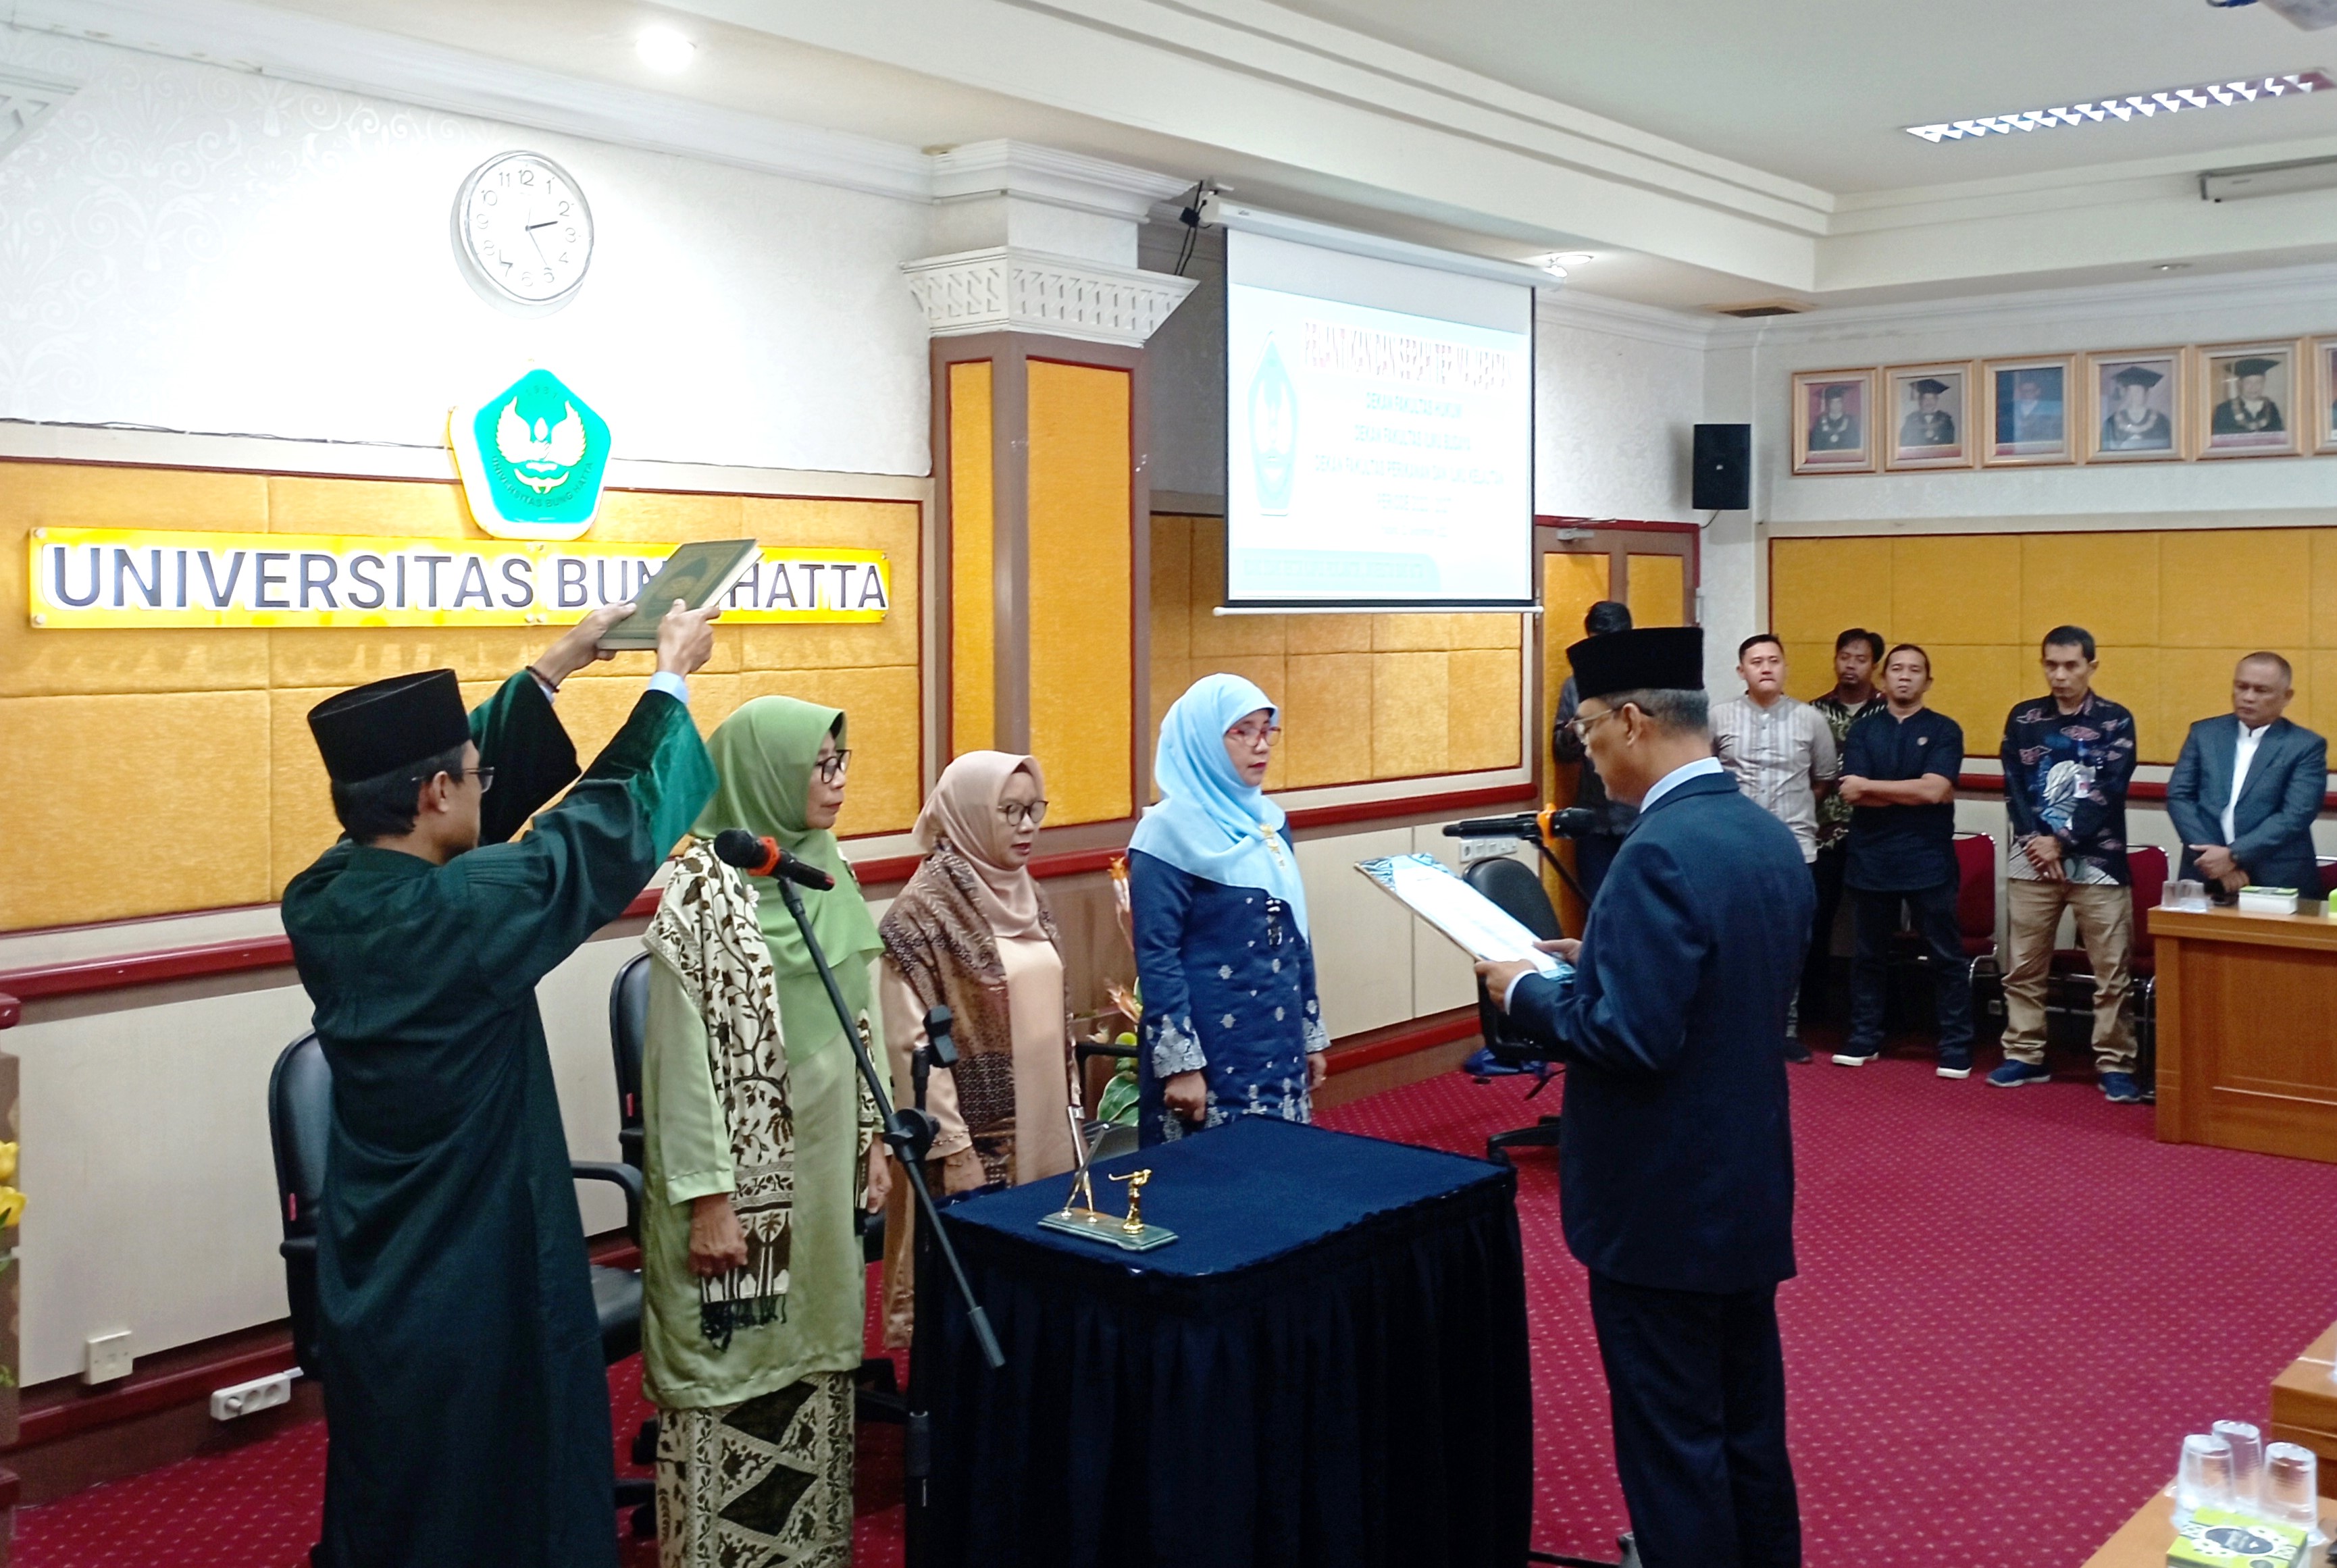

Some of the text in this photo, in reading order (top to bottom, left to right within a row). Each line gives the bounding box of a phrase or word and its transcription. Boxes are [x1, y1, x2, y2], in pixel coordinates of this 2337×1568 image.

[498, 172, 511, 188] 11
[518, 169, 534, 186] 12
[546, 180, 551, 194] 1
[481, 190, 498, 207] 10
[558, 201, 570, 217] 2
[476, 213, 488, 230] 9
[565, 227, 576, 243] 3
[484, 240, 495, 256] 8
[558, 251, 569, 263] 4
[521, 271, 534, 287] 6
[543, 267, 555, 283] 5
[492, 455, 594, 508] UNIVERSITAS BUNG HATTA
[53, 546, 888, 609] UNIVERSITAS BUN HATTA
